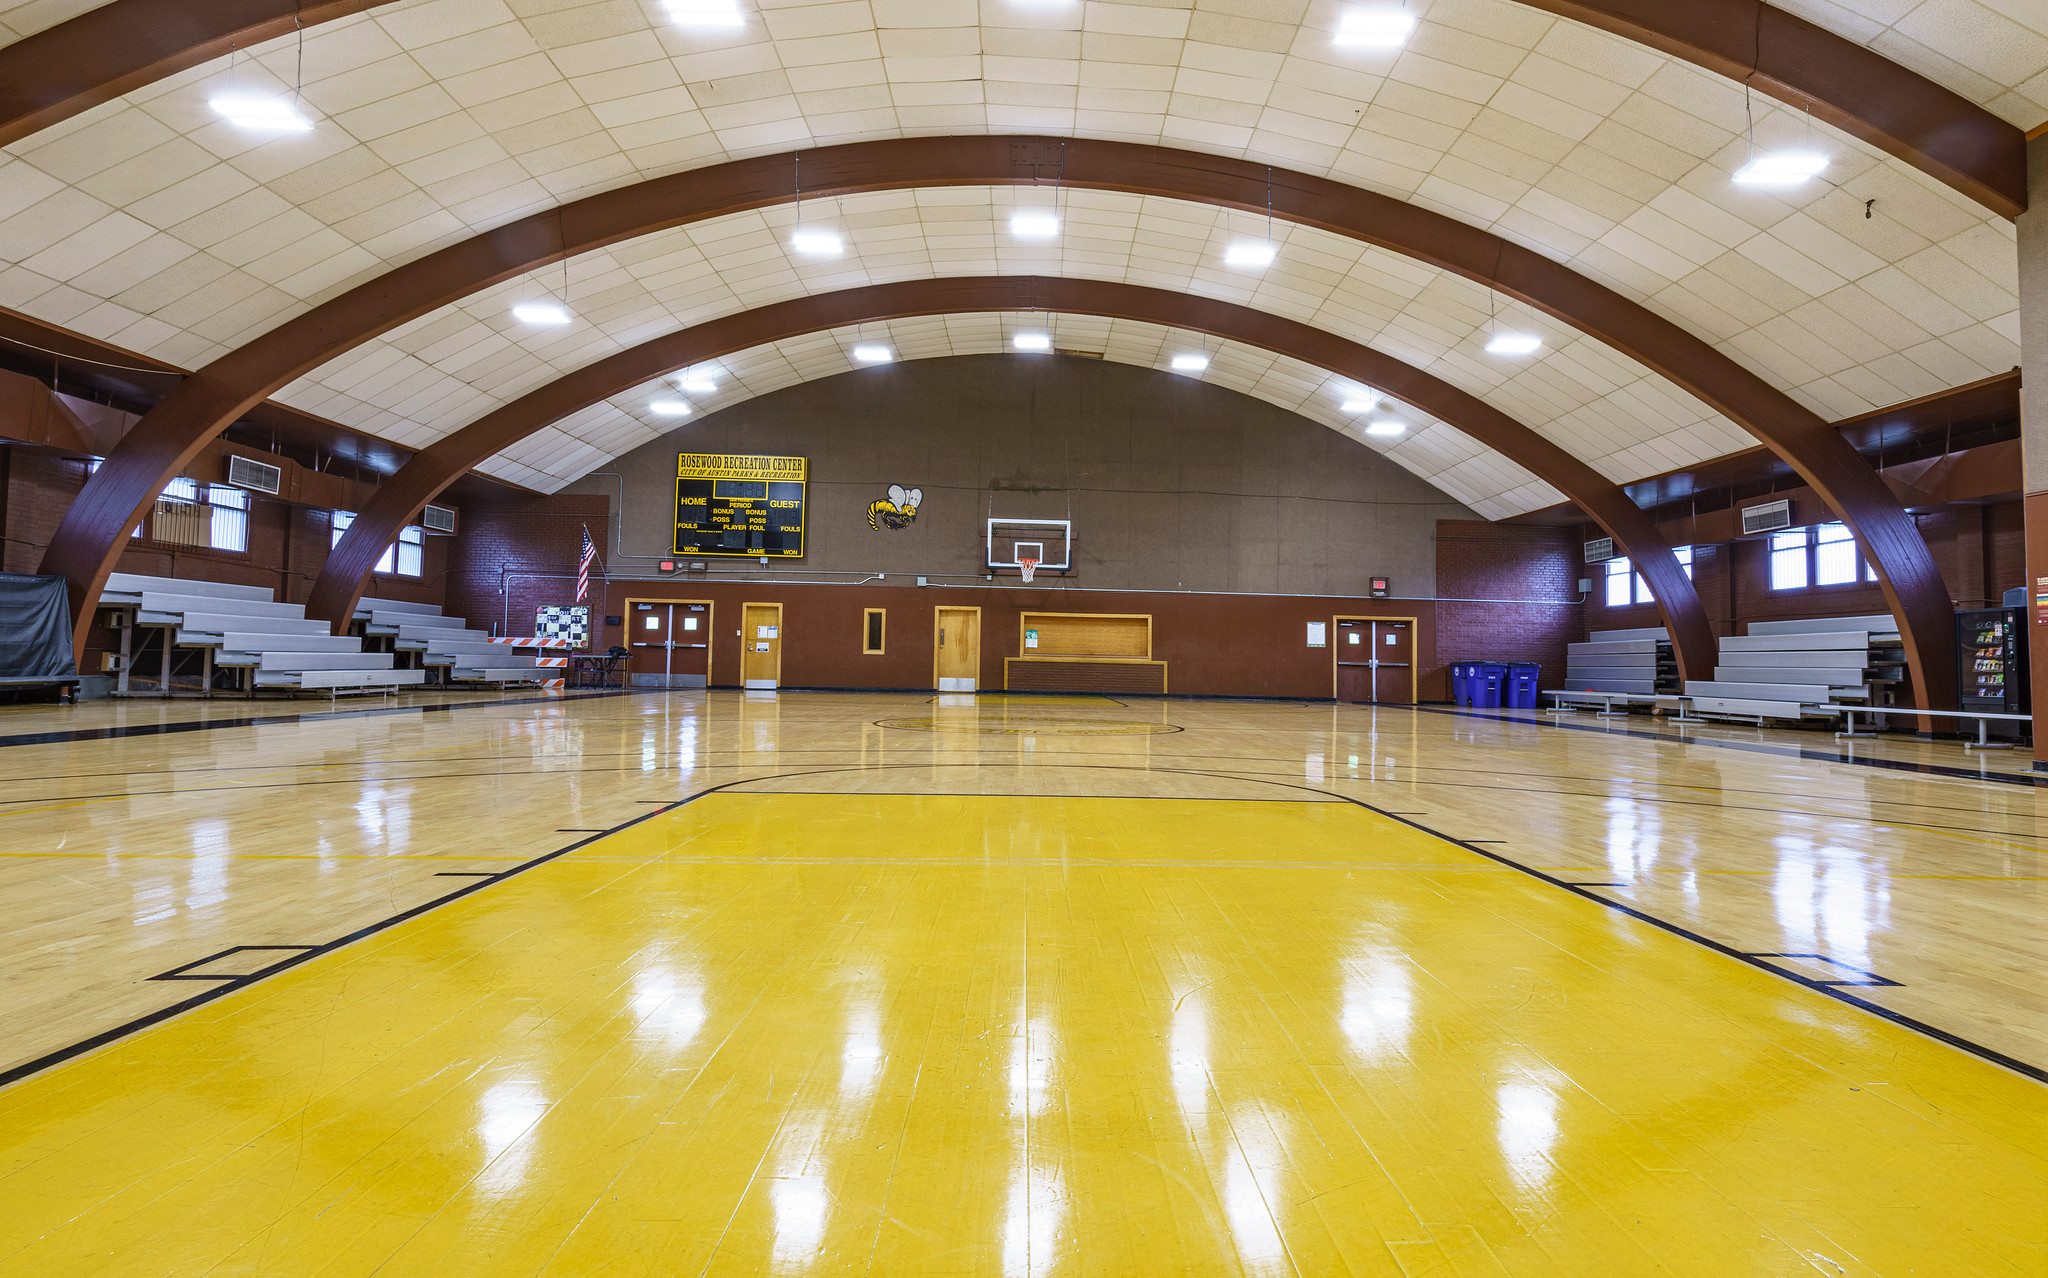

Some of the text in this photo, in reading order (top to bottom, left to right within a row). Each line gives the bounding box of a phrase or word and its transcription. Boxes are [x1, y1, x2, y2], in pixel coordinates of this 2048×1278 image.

[681, 455, 802, 471] ROSEWOOD RECREATION CENTER
[731, 470, 754, 478] PARKS
[760, 471, 801, 479] RECREATION
[770, 500, 800, 508] GUEST
